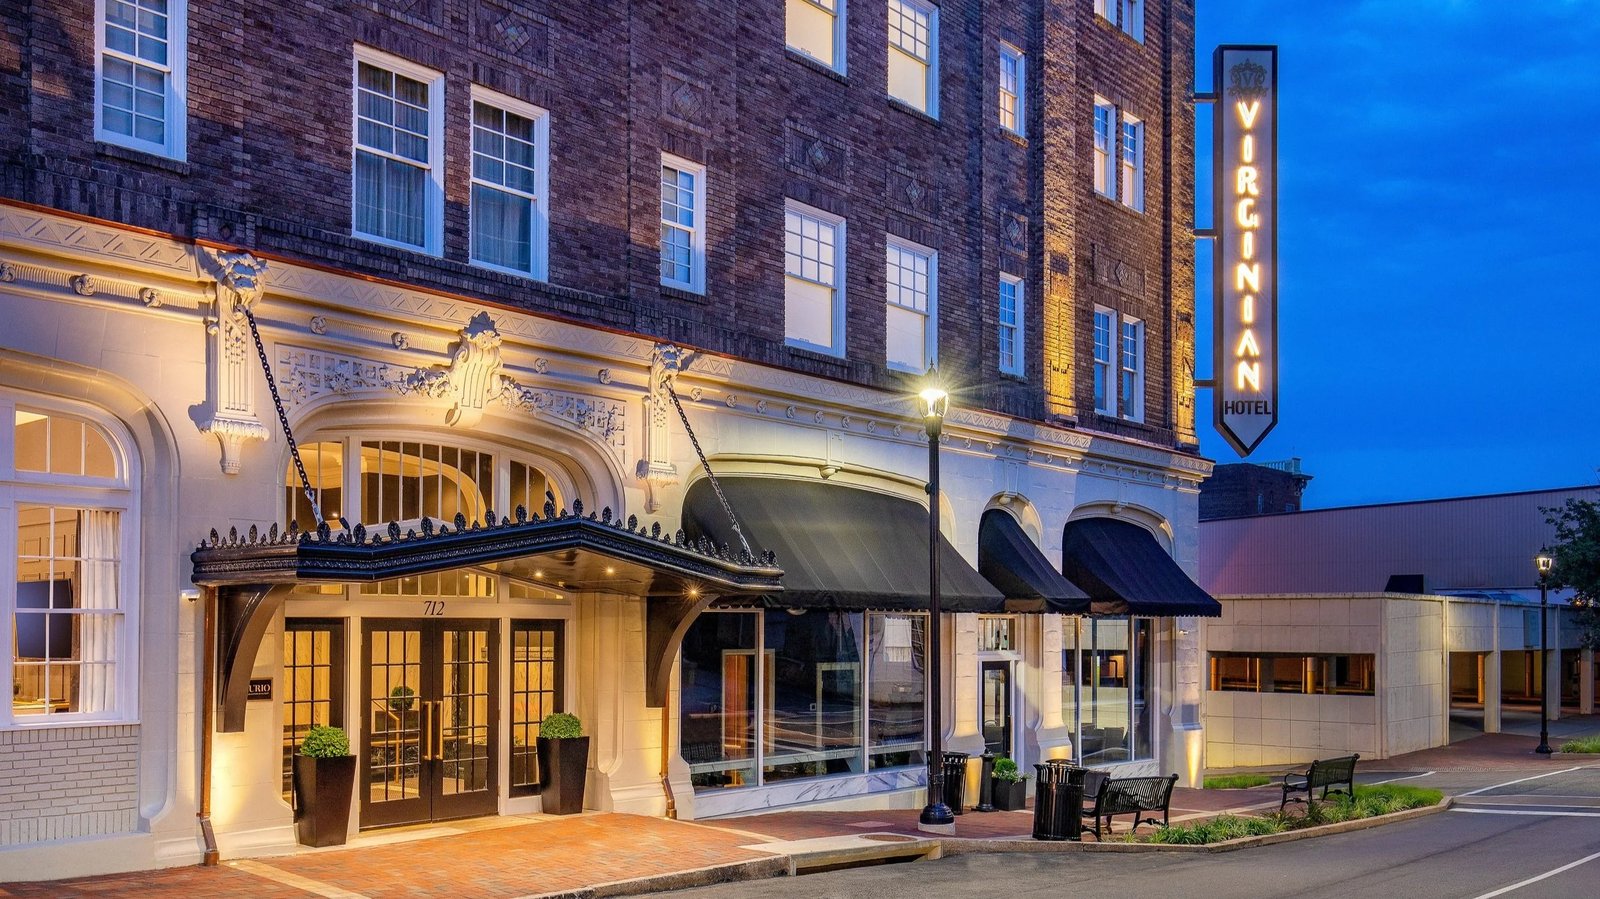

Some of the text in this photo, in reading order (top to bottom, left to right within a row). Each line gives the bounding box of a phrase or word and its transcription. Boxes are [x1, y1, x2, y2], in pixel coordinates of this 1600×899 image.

[1236, 101, 1260, 391] VIRGINIAN
[1224, 400, 1272, 415] HOTEL
[423, 600, 445, 616] 712
[248, 684, 271, 693] URIO
